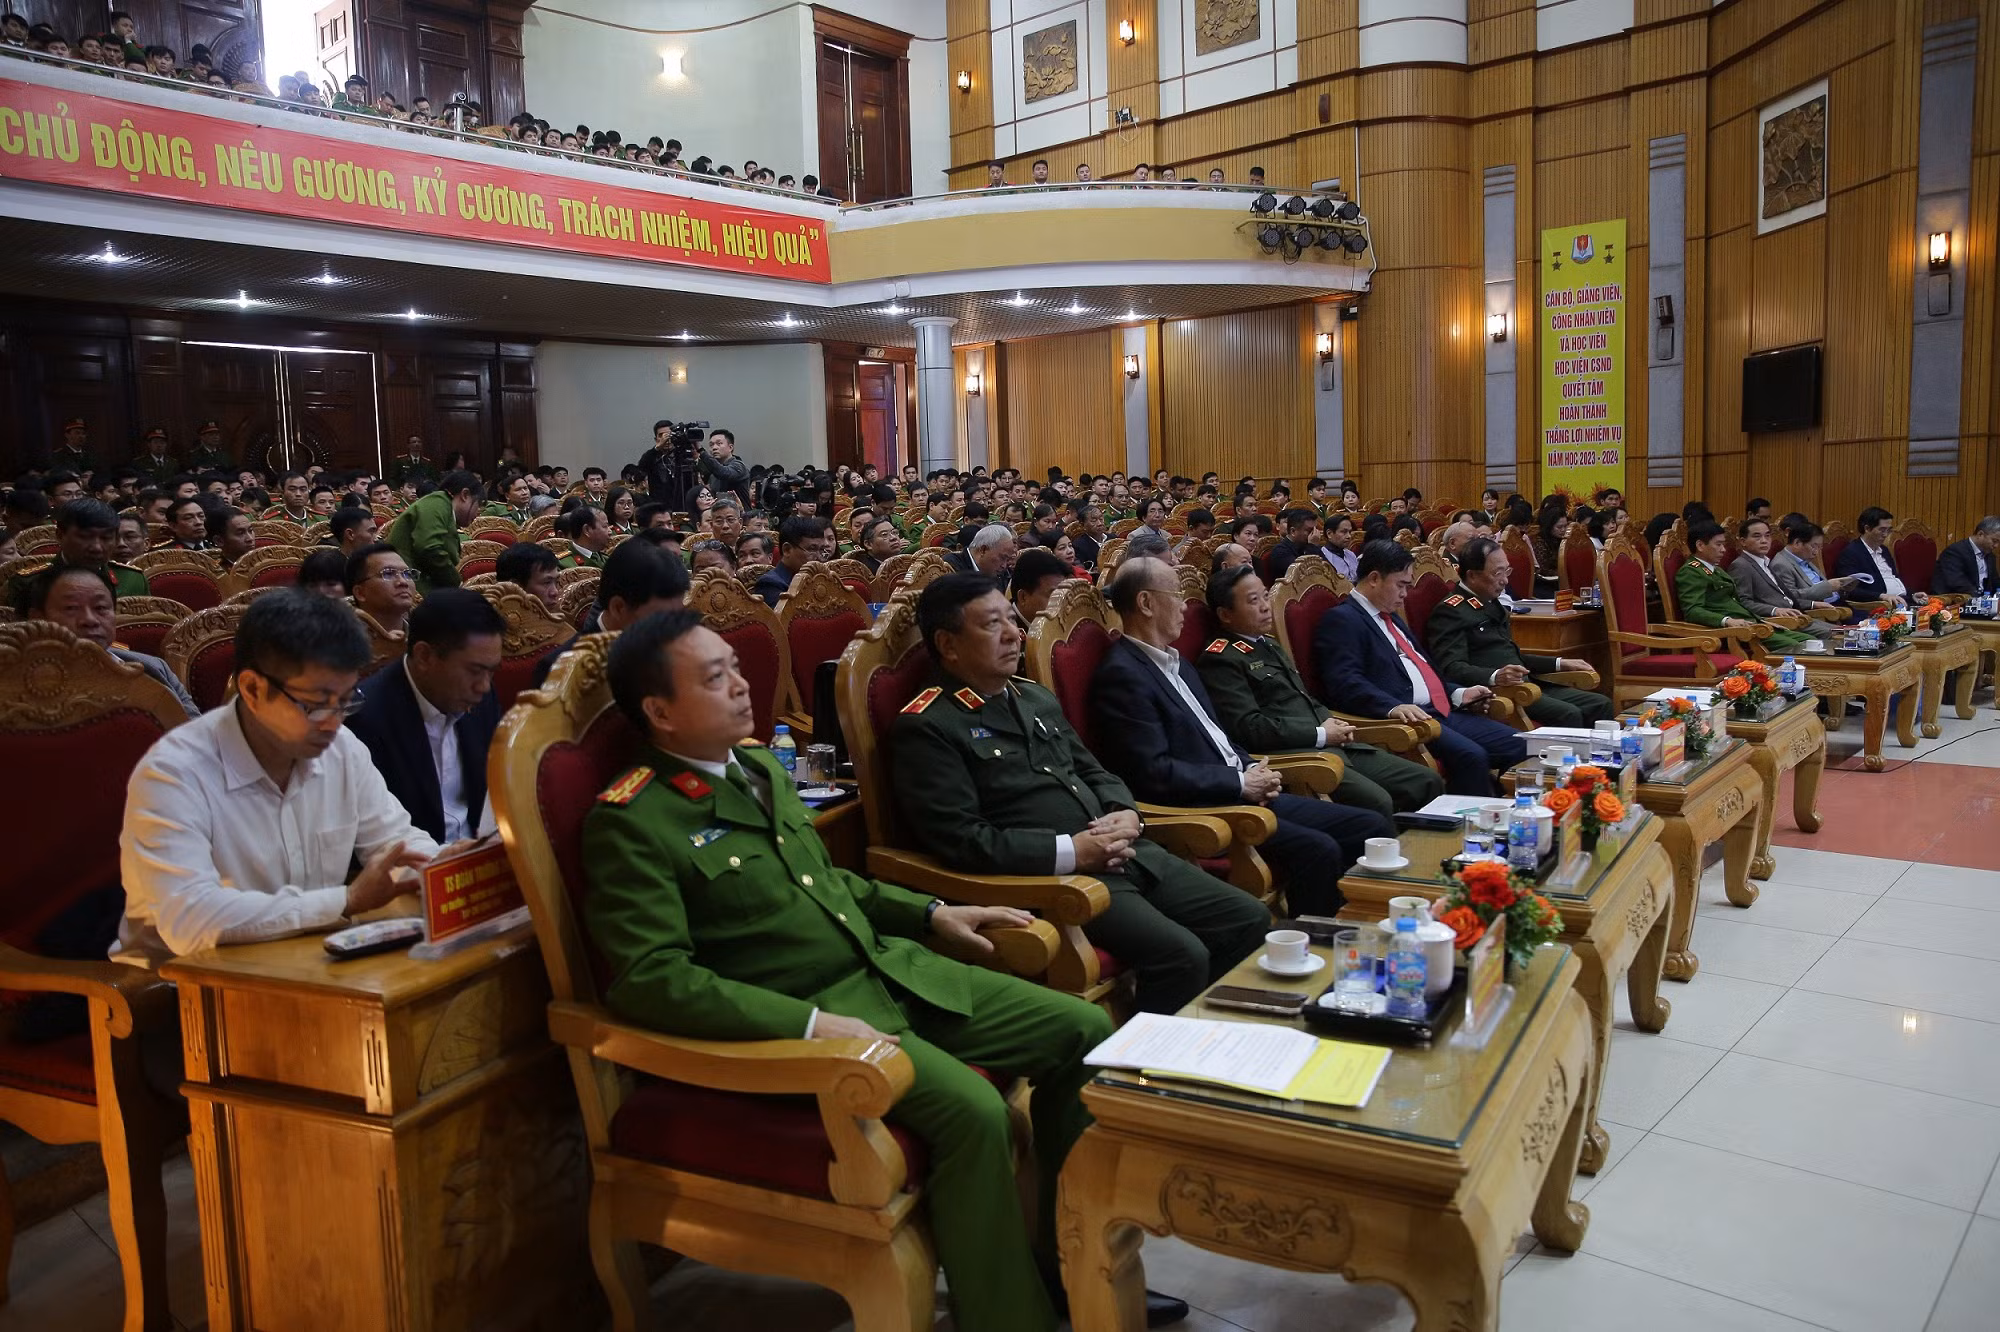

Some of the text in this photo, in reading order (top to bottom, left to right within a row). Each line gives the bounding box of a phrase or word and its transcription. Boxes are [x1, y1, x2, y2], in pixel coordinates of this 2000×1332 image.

[0, 102, 80, 163] CHỦ
[91, 119, 206, 188] ĐỘNG,
[215, 140, 283, 193] NÊU
[294, 156, 406, 215] GƯƠNG,
[413, 167, 447, 217] KỶ
[457, 181, 554, 235] CƯƠNG,
[559, 196, 636, 243] TRÁCH
[641, 209, 718, 258] NHIỆM,
[722, 220, 768, 265] HIỆU
[1545, 290, 1560, 307] CÁN
[1577, 283, 1600, 304] GIẢNG
[1552, 307, 1615, 329] CÔNG NHÂN VIÊN
[1560, 332, 1606, 353] VÀ HỌC VIÊN
[1555, 356, 1612, 378] HỌC VIỆN CSND
[1562, 377, 1604, 398] QUYẾT TÂM
[1559, 402, 1607, 421] HOÀN THÀNH
[1546, 425, 1622, 446] THẮNG LỢI NHIỆM VỤ
[1548, 450, 1563, 467] NĂM
[1565, 452, 1578, 468] HỌC
[1579, 451, 1596, 465] 2023
[1602, 450, 1618, 464] 2024
